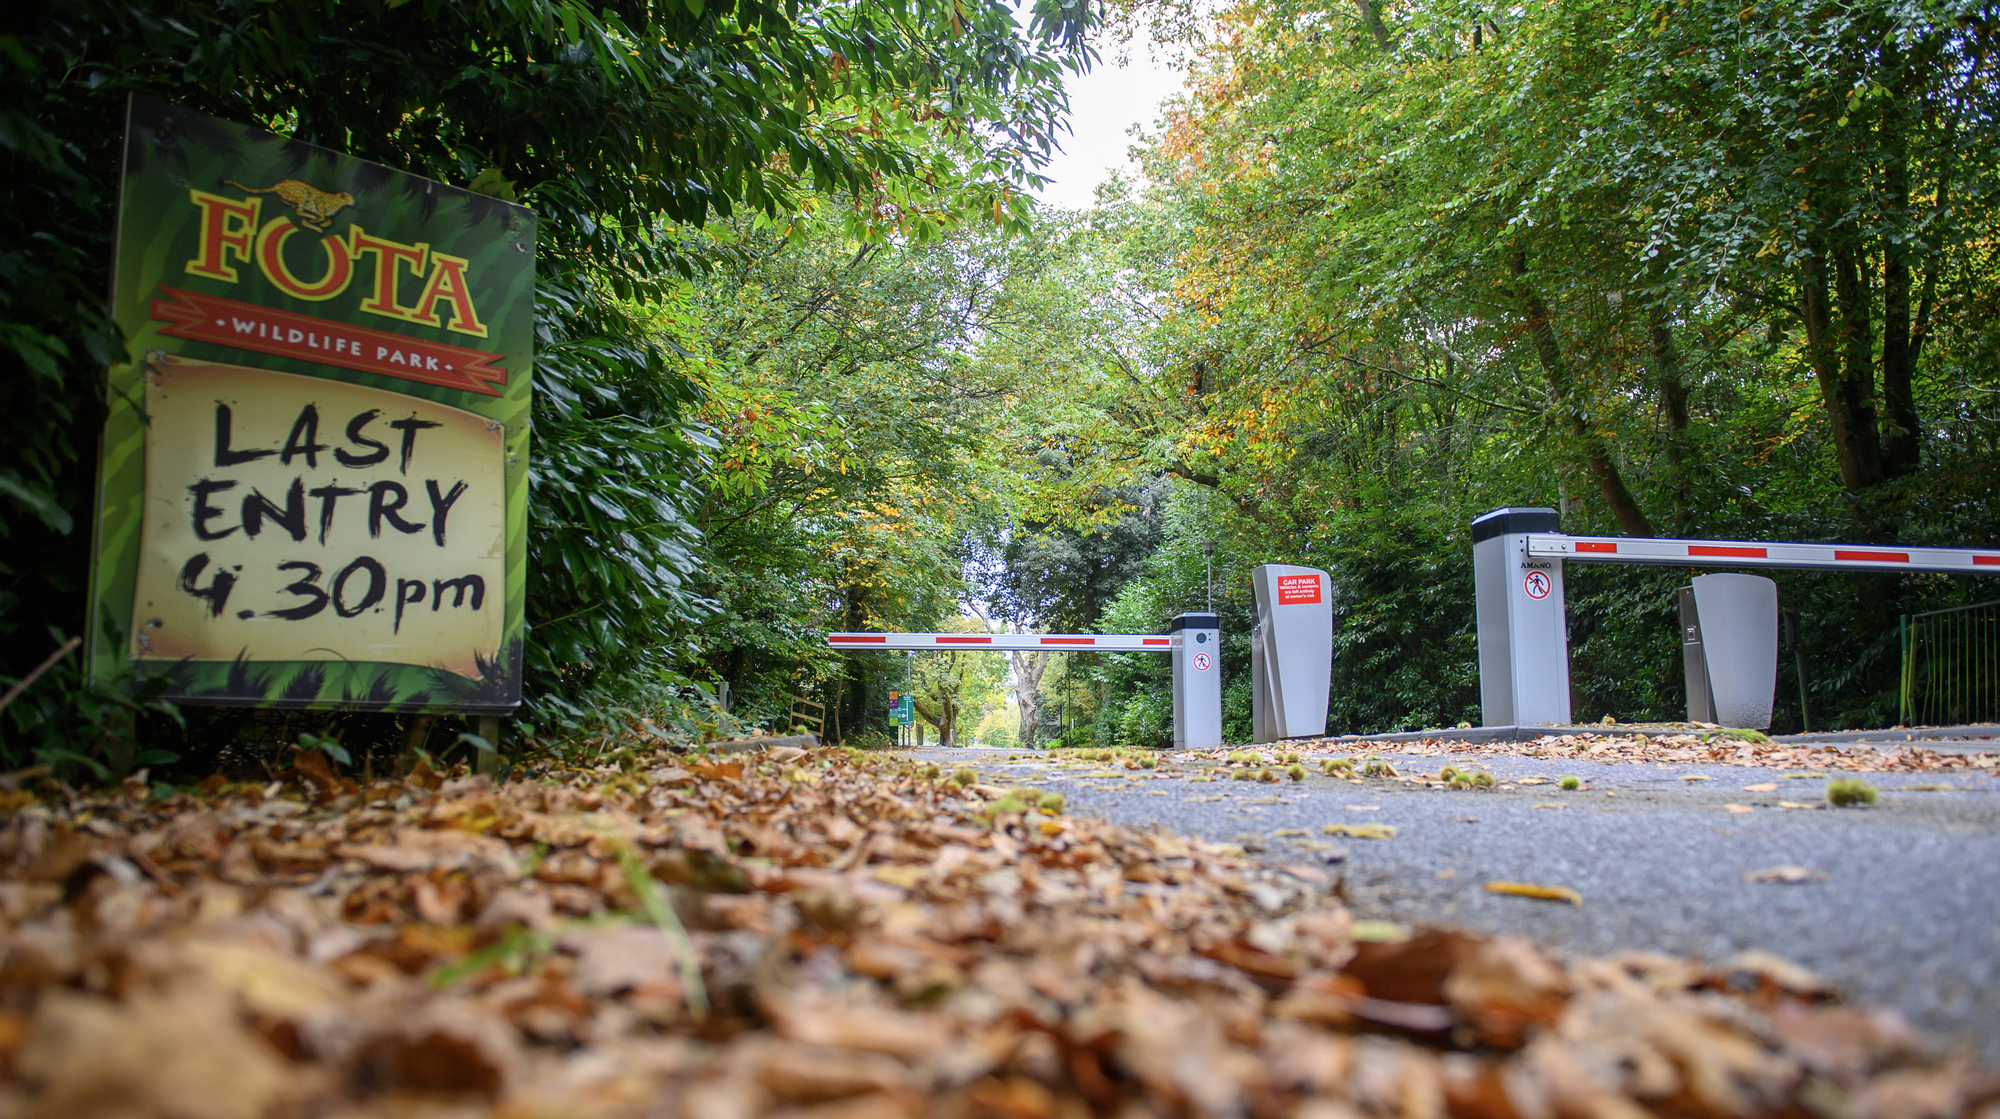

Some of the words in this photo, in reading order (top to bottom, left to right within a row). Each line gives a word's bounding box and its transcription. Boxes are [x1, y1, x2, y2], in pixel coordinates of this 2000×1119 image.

[184, 188, 488, 338] FOTA
[232, 317, 362, 356] WILDLIFE
[376, 346, 439, 371] PARK
[214, 401, 444, 476] LAST
[185, 474, 469, 547] ENTRY
